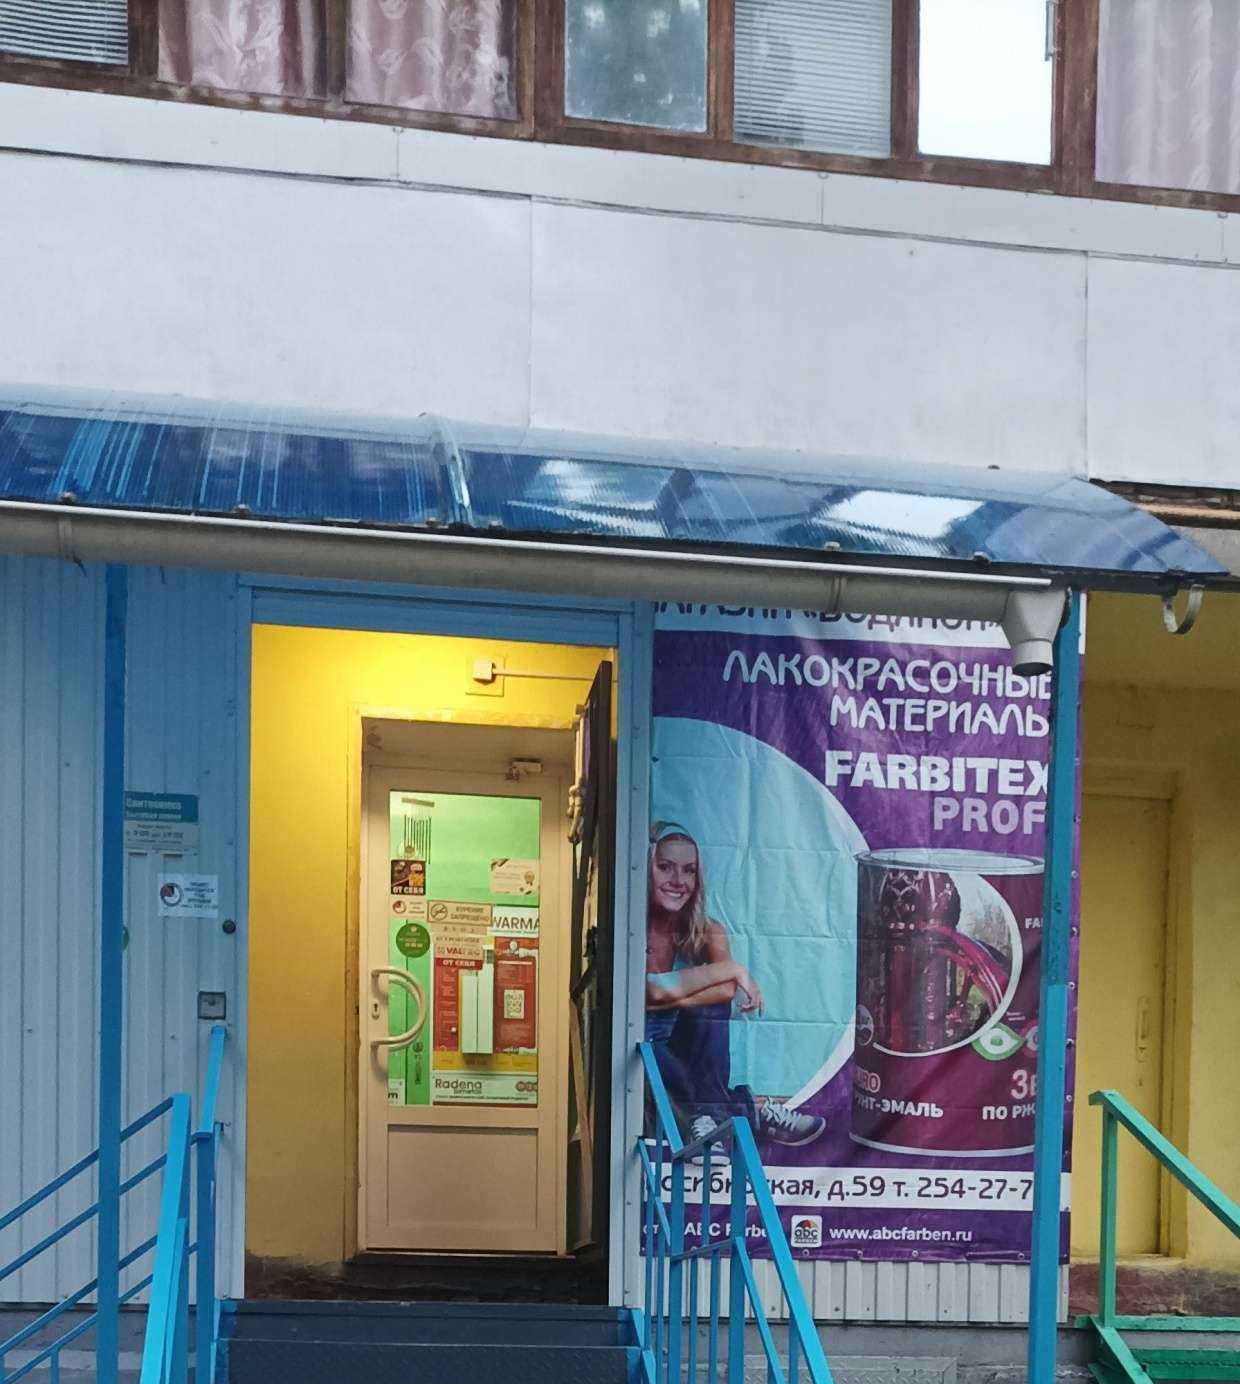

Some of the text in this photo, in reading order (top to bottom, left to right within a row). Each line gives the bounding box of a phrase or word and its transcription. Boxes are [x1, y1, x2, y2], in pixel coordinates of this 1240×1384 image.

[722, 650, 1052, 699] ЛАКОКРАСОЧНЫЕ
[825, 750, 1049, 796] FARBITEX
[933, 797, 1047, 835] PROF
[982, 1106, 1008, 1120] ПО
[828, 1175, 886, 1201] д.59
[893, 1181, 910, 1198] т.
[829, 1226, 972, 1242] www.abcfarben.ru
